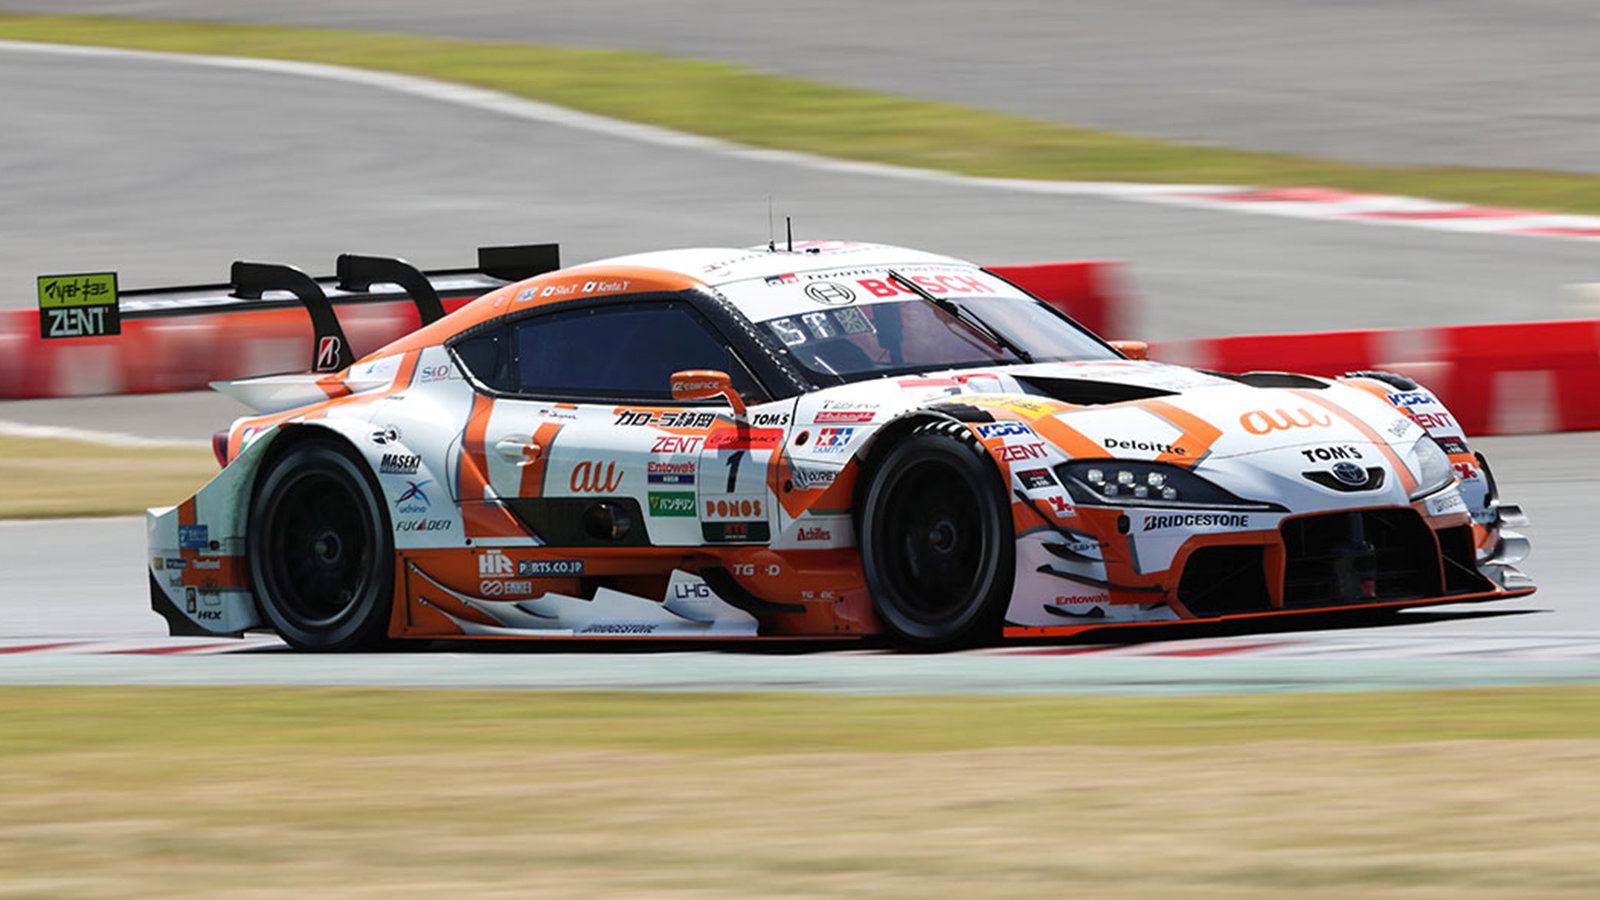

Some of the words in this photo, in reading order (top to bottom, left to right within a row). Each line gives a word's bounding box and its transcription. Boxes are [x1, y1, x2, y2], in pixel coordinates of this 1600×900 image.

[856, 275, 996, 298] BOSCH
[48, 307, 105, 337] ZENT
[1387, 392, 1436, 406] KDDI
[614, 410, 717, 428] カローラ静岡
[752, 413, 790, 426] TOM'S
[1239, 408, 1332, 435] au
[976, 422, 1030, 439] KDDI
[651, 437, 704, 453] ZENT
[994, 441, 1049, 462] ZENT
[1301, 444, 1364, 463] TOM'S
[381, 453, 422, 470] MASEKI
[570, 460, 625, 493] au
[726, 450, 746, 494] 1
[659, 499, 695, 511] バンテリン
[705, 500, 763, 518] PONOS
[1143, 514, 1249, 531] BRIDGESTONE
[797, 527, 832, 541] Achilles
[675, 583, 710, 599] LHG
